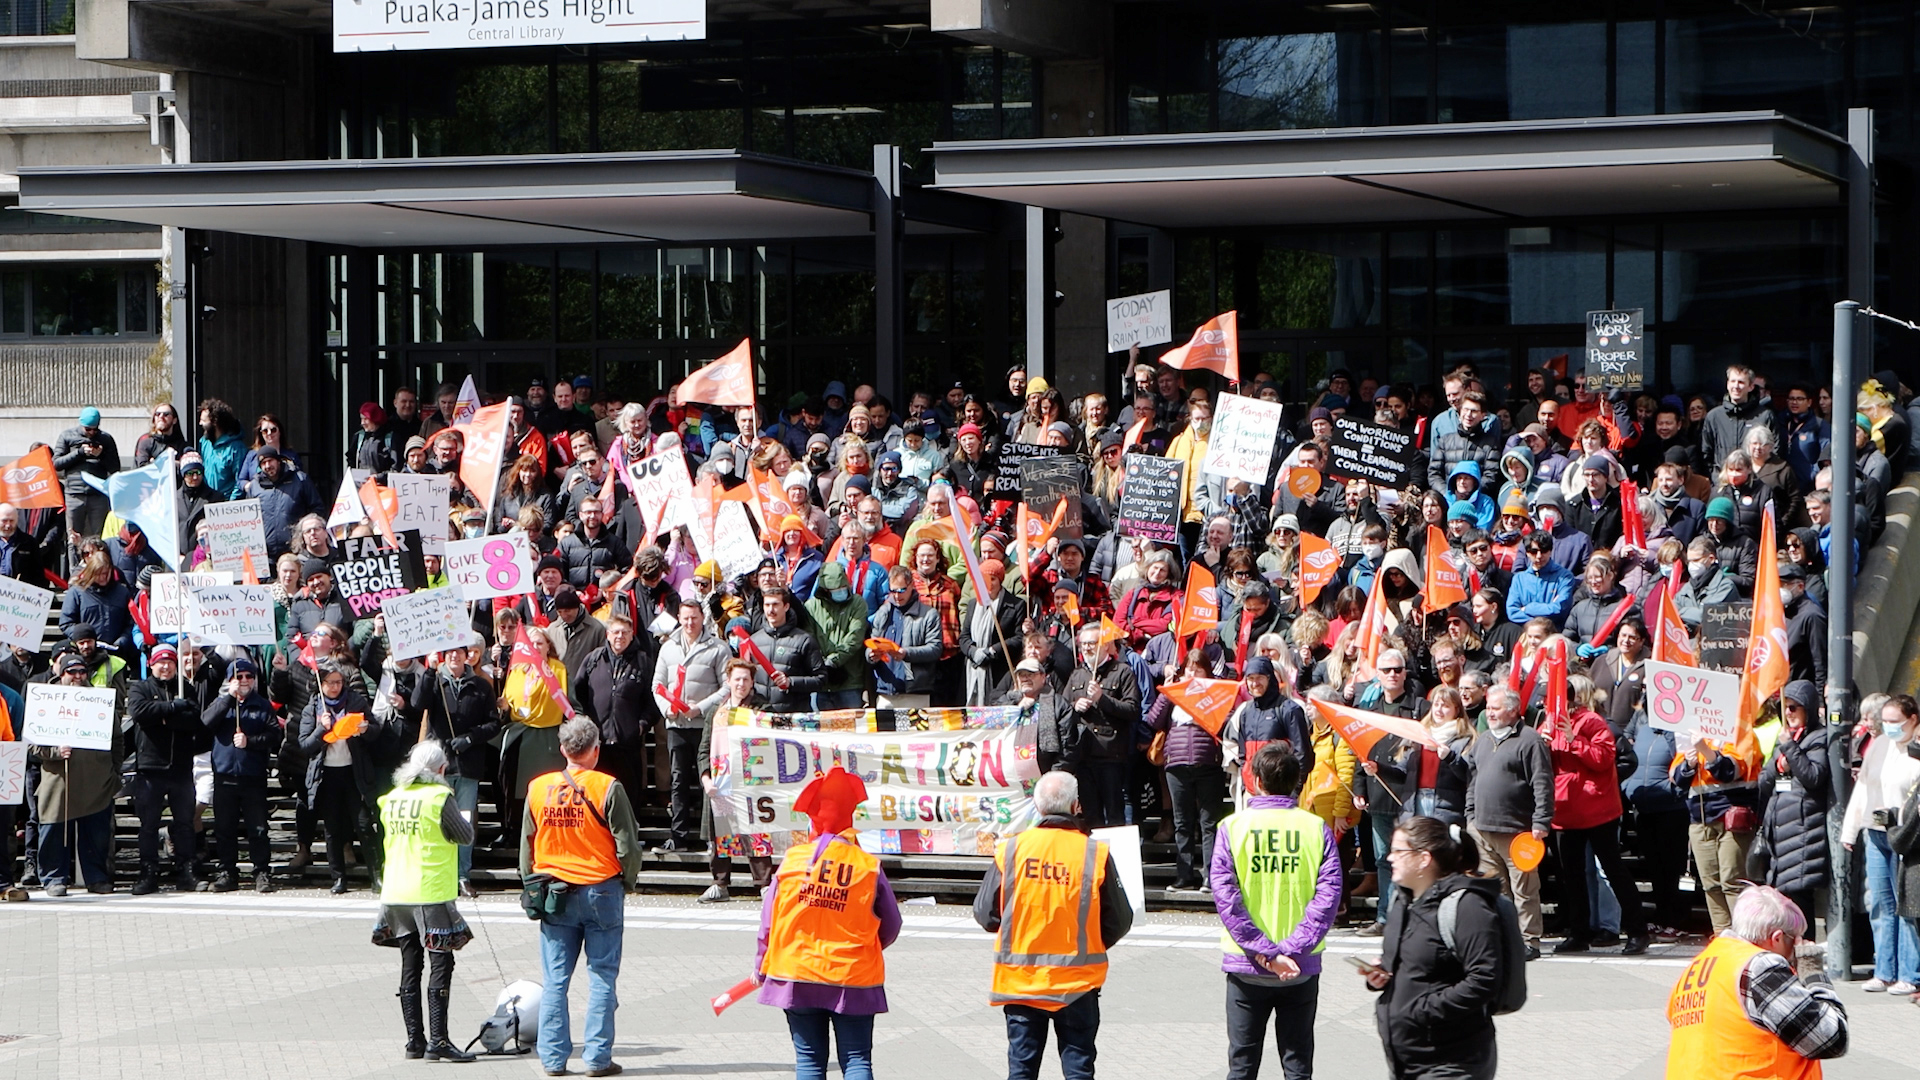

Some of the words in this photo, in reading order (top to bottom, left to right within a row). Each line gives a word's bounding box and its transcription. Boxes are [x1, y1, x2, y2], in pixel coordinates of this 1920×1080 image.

[384, 0, 549, 24] Puaka-James
[563, 0, 635, 23] Hight
[467, 27, 516, 41] Central
[518, 25, 566, 40] Library
[1113, 295, 1156, 319] TODAY
[1592, 313, 1630, 327] HARD
[1113, 328, 1140, 347] RAINY
[1146, 325, 1167, 340] DAY
[1594, 324, 1634, 337] WORK
[1590, 348, 1638, 363] PROPER
[1601, 361, 1628, 374] PAY
[1336, 418, 1357, 432] OUR
[1360, 424, 1410, 445] WORKING
[1343, 430, 1403, 453] CONDITIONS
[1331, 445, 1358, 460] THEIR
[1361, 454, 1405, 472] LEARNING
[1335, 458, 1397, 482] CONDITIONS
[392, 480, 420, 498] LET
[1128, 485, 1156, 496] March
[1123, 495, 1174, 508] Coronavirus
[1124, 509, 1149, 519] Crap
[1151, 512, 1171, 525] pay
[1134, 520, 1176, 532] DESERVE
[333, 555, 401, 583] PEOPLE
[448, 553, 480, 570] GIVE
[457, 571, 480, 585] US
[1303, 572, 1320, 582] TEU
[1435, 570, 1457, 582] TEU
[338, 573, 404, 599] BEFORE
[192, 588, 234, 604] THANK
[199, 607, 237, 618] WONT
[245, 606, 266, 617] PAY
[1192, 606, 1213, 618] TEU
[200, 623, 226, 635] THE
[239, 621, 273, 634] BILLS
[31, 686, 68, 702] STAFF
[1653, 671, 1712, 725] 8%
[1195, 695, 1214, 711] TEU
[58, 705, 80, 718] ARE
[1694, 706, 1725, 718] FAIR
[28, 722, 71, 737] STUDENT
[1343, 720, 1367, 735] TEU
[1699, 716, 1724, 727] PAY
[740, 737, 1010, 788] EDUCATION
[545, 785, 585, 806] TEU
[389, 799, 423, 820] TEU
[543, 806, 584, 819] BRANCH
[746, 796, 776, 824] IS
[880, 795, 1012, 824] BUSINESS
[389, 820, 420, 836] STAFF
[543, 818, 584, 828] PRESIDENT
[1250, 829, 1300, 854] TEU
[1251, 855, 1300, 874] STAFF
[800, 882, 849, 902] BRANCH
[798, 894, 847, 913] PRESIDENT
[1674, 989, 1707, 1014] RANCH
[1672, 1009, 1705, 1030] RESIDENT
